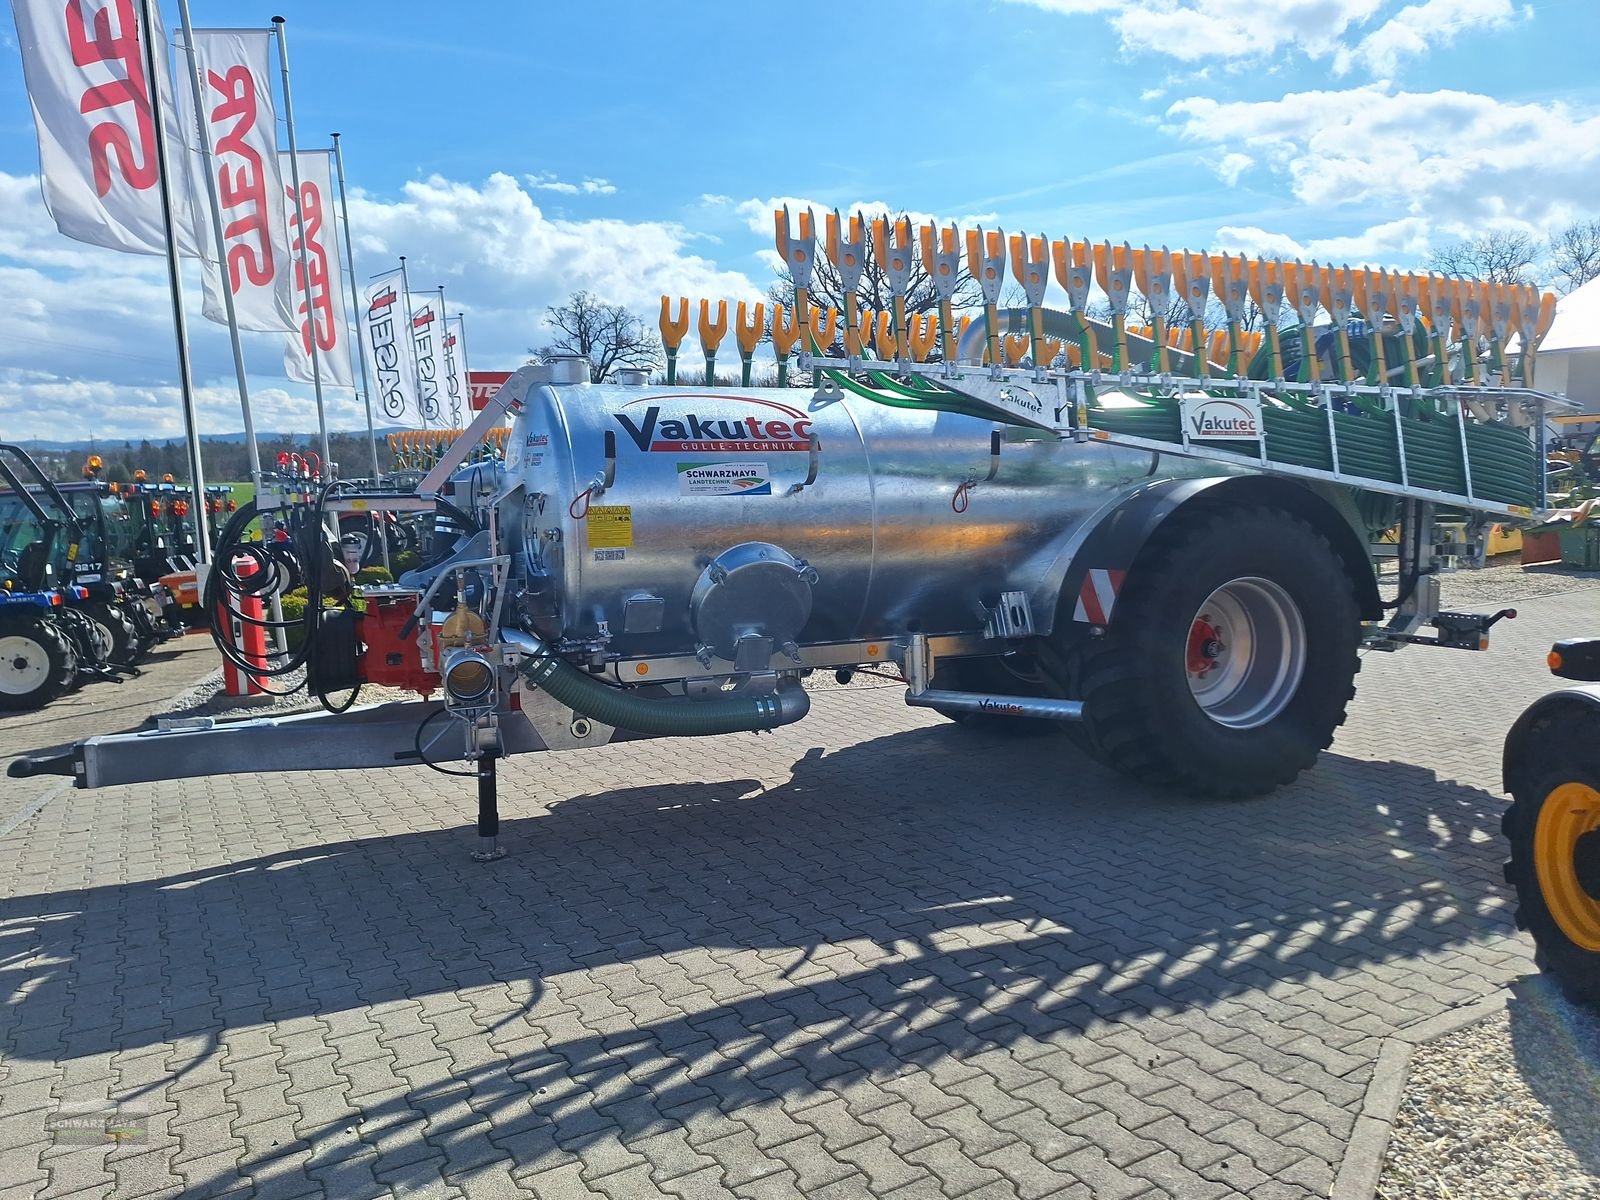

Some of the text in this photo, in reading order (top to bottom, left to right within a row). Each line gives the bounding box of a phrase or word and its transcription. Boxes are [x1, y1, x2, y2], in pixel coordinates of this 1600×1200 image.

[1000, 388, 1042, 414] Vakutec
[613, 406, 813, 452] Vakutec
[1191, 410, 1257, 435] Vakutec
[686, 470, 757, 478] SCHWARZMAYR
[74, 562, 102, 572] 3217
[978, 698, 1024, 712] Vakutec
